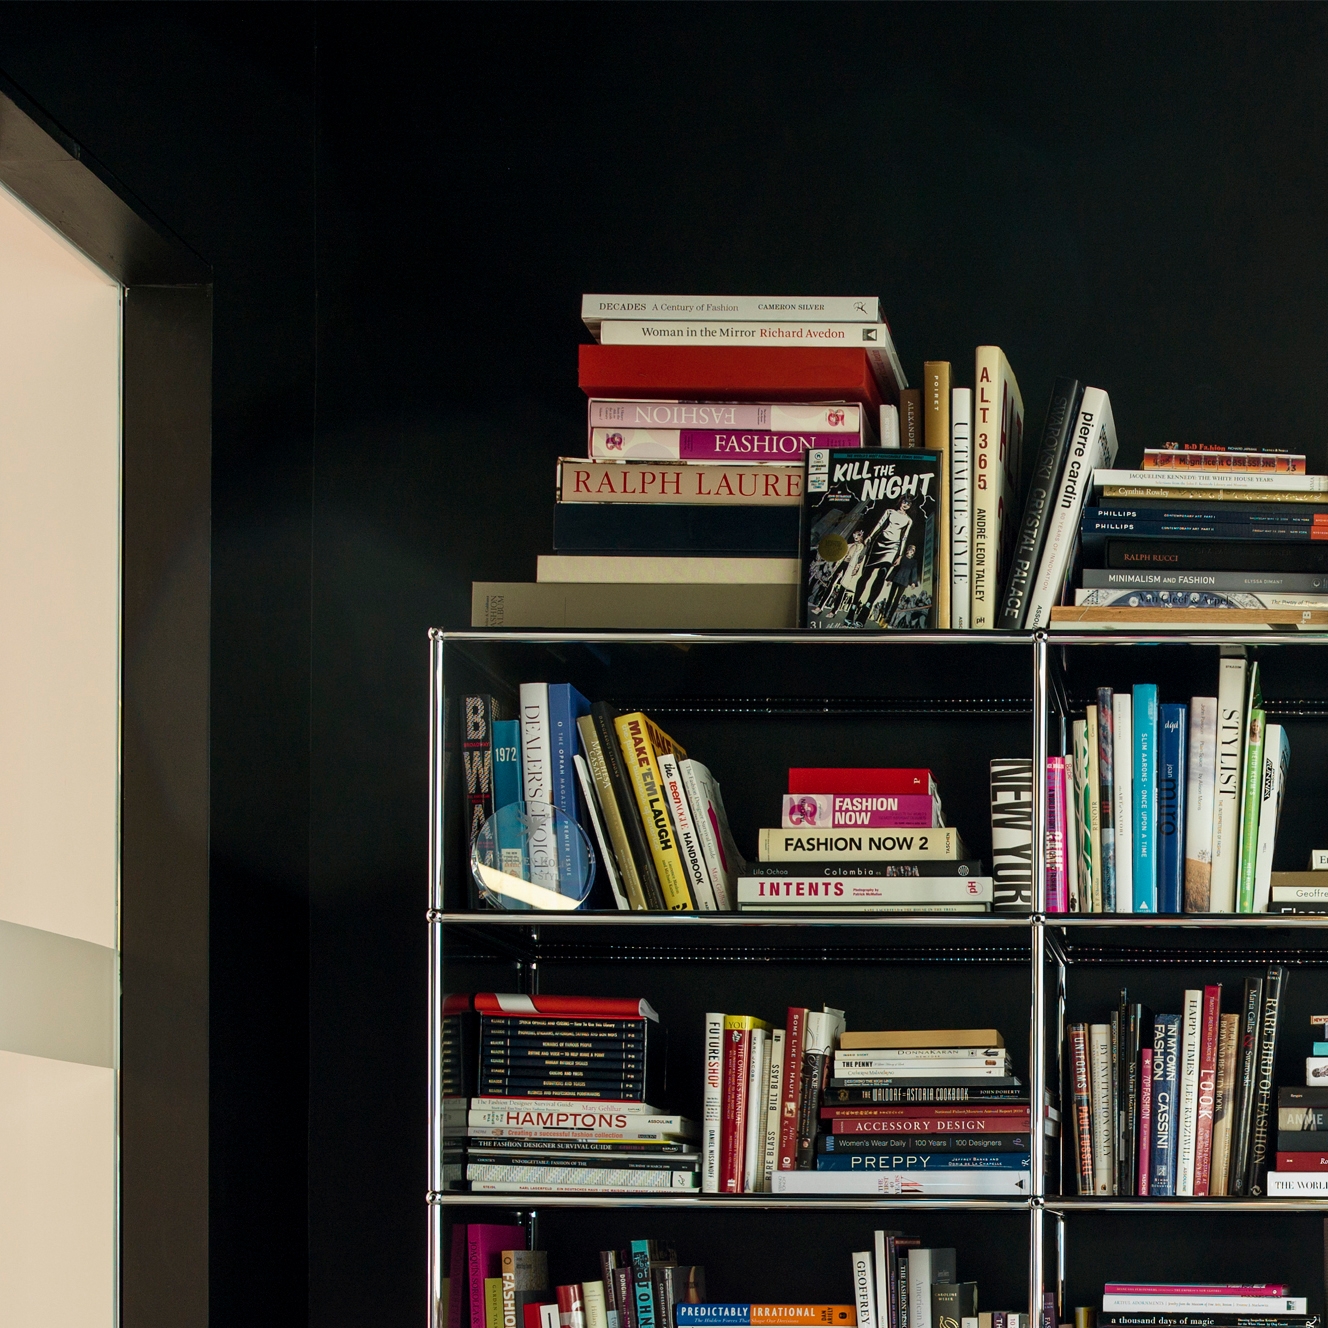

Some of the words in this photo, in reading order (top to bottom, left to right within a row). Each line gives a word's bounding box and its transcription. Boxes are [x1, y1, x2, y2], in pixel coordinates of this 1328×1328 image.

[599, 303, 647, 311] DECADES
[660, 303, 698, 313] Century
[700, 303, 705, 312] of
[706, 303, 739, 312] Fashion
[641, 327, 684, 337] Woman
[686, 327, 697, 337] in
[699, 327, 717, 337] the
[719, 327, 756, 338] Mirror
[759, 328, 803, 339] Richard
[805, 328, 845, 339] Avedon
[635, 406, 736, 425] FASHION
[1042, 397, 1067, 480] SWAROVSKI
[1073, 411, 1094, 458] pierre
[714, 435, 816, 454] FASHION
[833, 460, 873, 483] KILL
[873, 464, 896, 477] THE
[953, 422, 969, 520] ULTIMATE
[573, 470, 683, 495] RALPH
[696, 473, 803, 497] LAURE
[861, 472, 935, 501] NIGHT
[1061, 460, 1082, 509] cardin
[1118, 487, 1145, 497] Cynthia
[1146, 488, 1170, 498] Rowley
[977, 508, 988, 539] ANDRÉ
[1018, 487, 1047, 554] CRYSTAL
[1098, 510, 1137, 518] PHILLIPS
[953, 525, 968, 585] STYLE
[975, 540, 986, 565] LEON
[1124, 553, 1151, 561] RALPH
[1152, 554, 1178, 562] RUCCI
[974, 567, 985, 602] TALLEY
[1108, 574, 1161, 583] MINIMALISM
[1178, 575, 1215, 584] FASHION
[1004, 559, 1032, 620] PALACE
[495, 747, 517, 762] 1972
[1219, 708, 1240, 800] STYLIST
[627, 719, 650, 768] MAKE
[648, 797, 673, 851] LAUGH
[835, 797, 898, 811] FASHION
[834, 812, 871, 825] NOW
[784, 837, 862, 851] FASHION
[868, 836, 915, 850] NOW
[918, 836, 929, 850] 2
[824, 868, 875, 876] Colombia
[758, 882, 844, 896] INTENTS
[707, 1021, 719, 1088] FUTURESHOP
[1199, 1069, 1215, 1119] LOOK
[506, 1111, 627, 1129] HAMPTONS
[856, 1121, 931, 1131] ACCESSORY
[937, 1120, 986, 1130] DESIGN
[1157, 1092, 1170, 1149] CASSINI
[851, 1156, 931, 1168] PREPPY
[856, 1260, 870, 1326] GEOFFREY
[681, 1306, 748, 1317] PREDICTABLY
[753, 1307, 816, 1317] IRRATIONAL
[1118, 1316, 1156, 1325] thousand
[1158, 1317, 1177, 1327] days
[1179, 1317, 1188, 1325] of
[1190, 1317, 1215, 1327] magic
